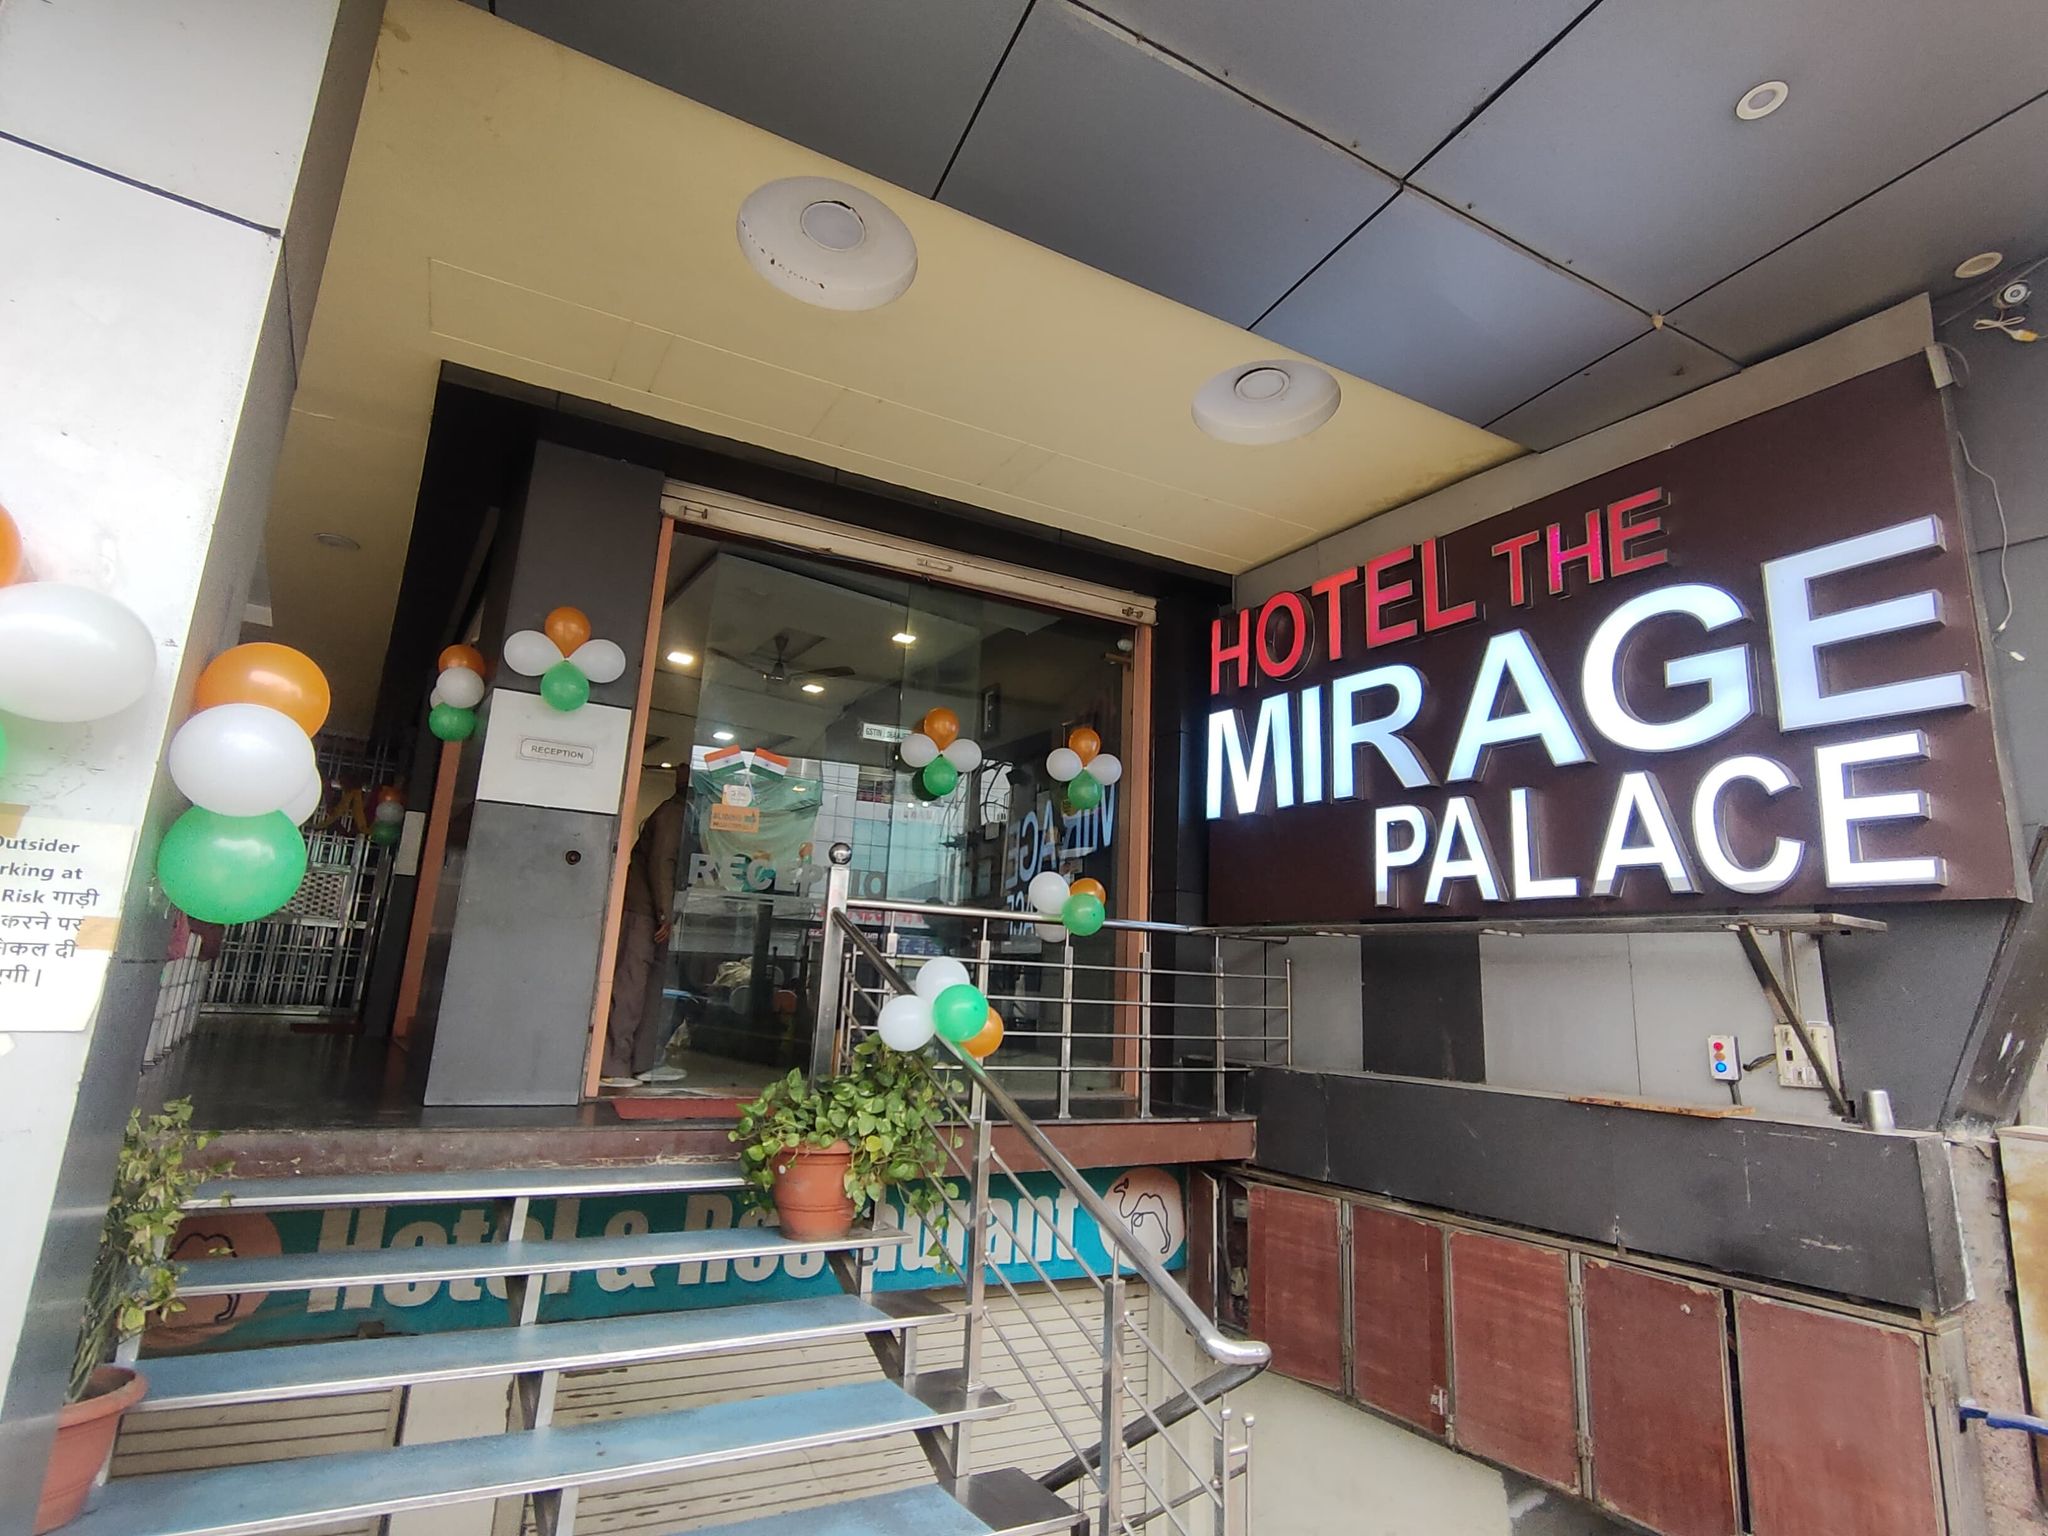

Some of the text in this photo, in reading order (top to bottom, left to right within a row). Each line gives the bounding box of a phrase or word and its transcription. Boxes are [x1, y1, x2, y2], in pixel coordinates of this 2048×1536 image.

[1210, 487, 1669, 695] HOTEL THE
[1205, 513, 1976, 820] MIRAGE
[531, 745, 584, 760] RECEPTION
[1374, 729, 1947, 907] PALACE
[61, 868, 83, 880] at
[2, 888, 100, 909] Risk गाड़ी
[1, 911, 86, 931] करने पर
[55, 938, 79, 959] दी
